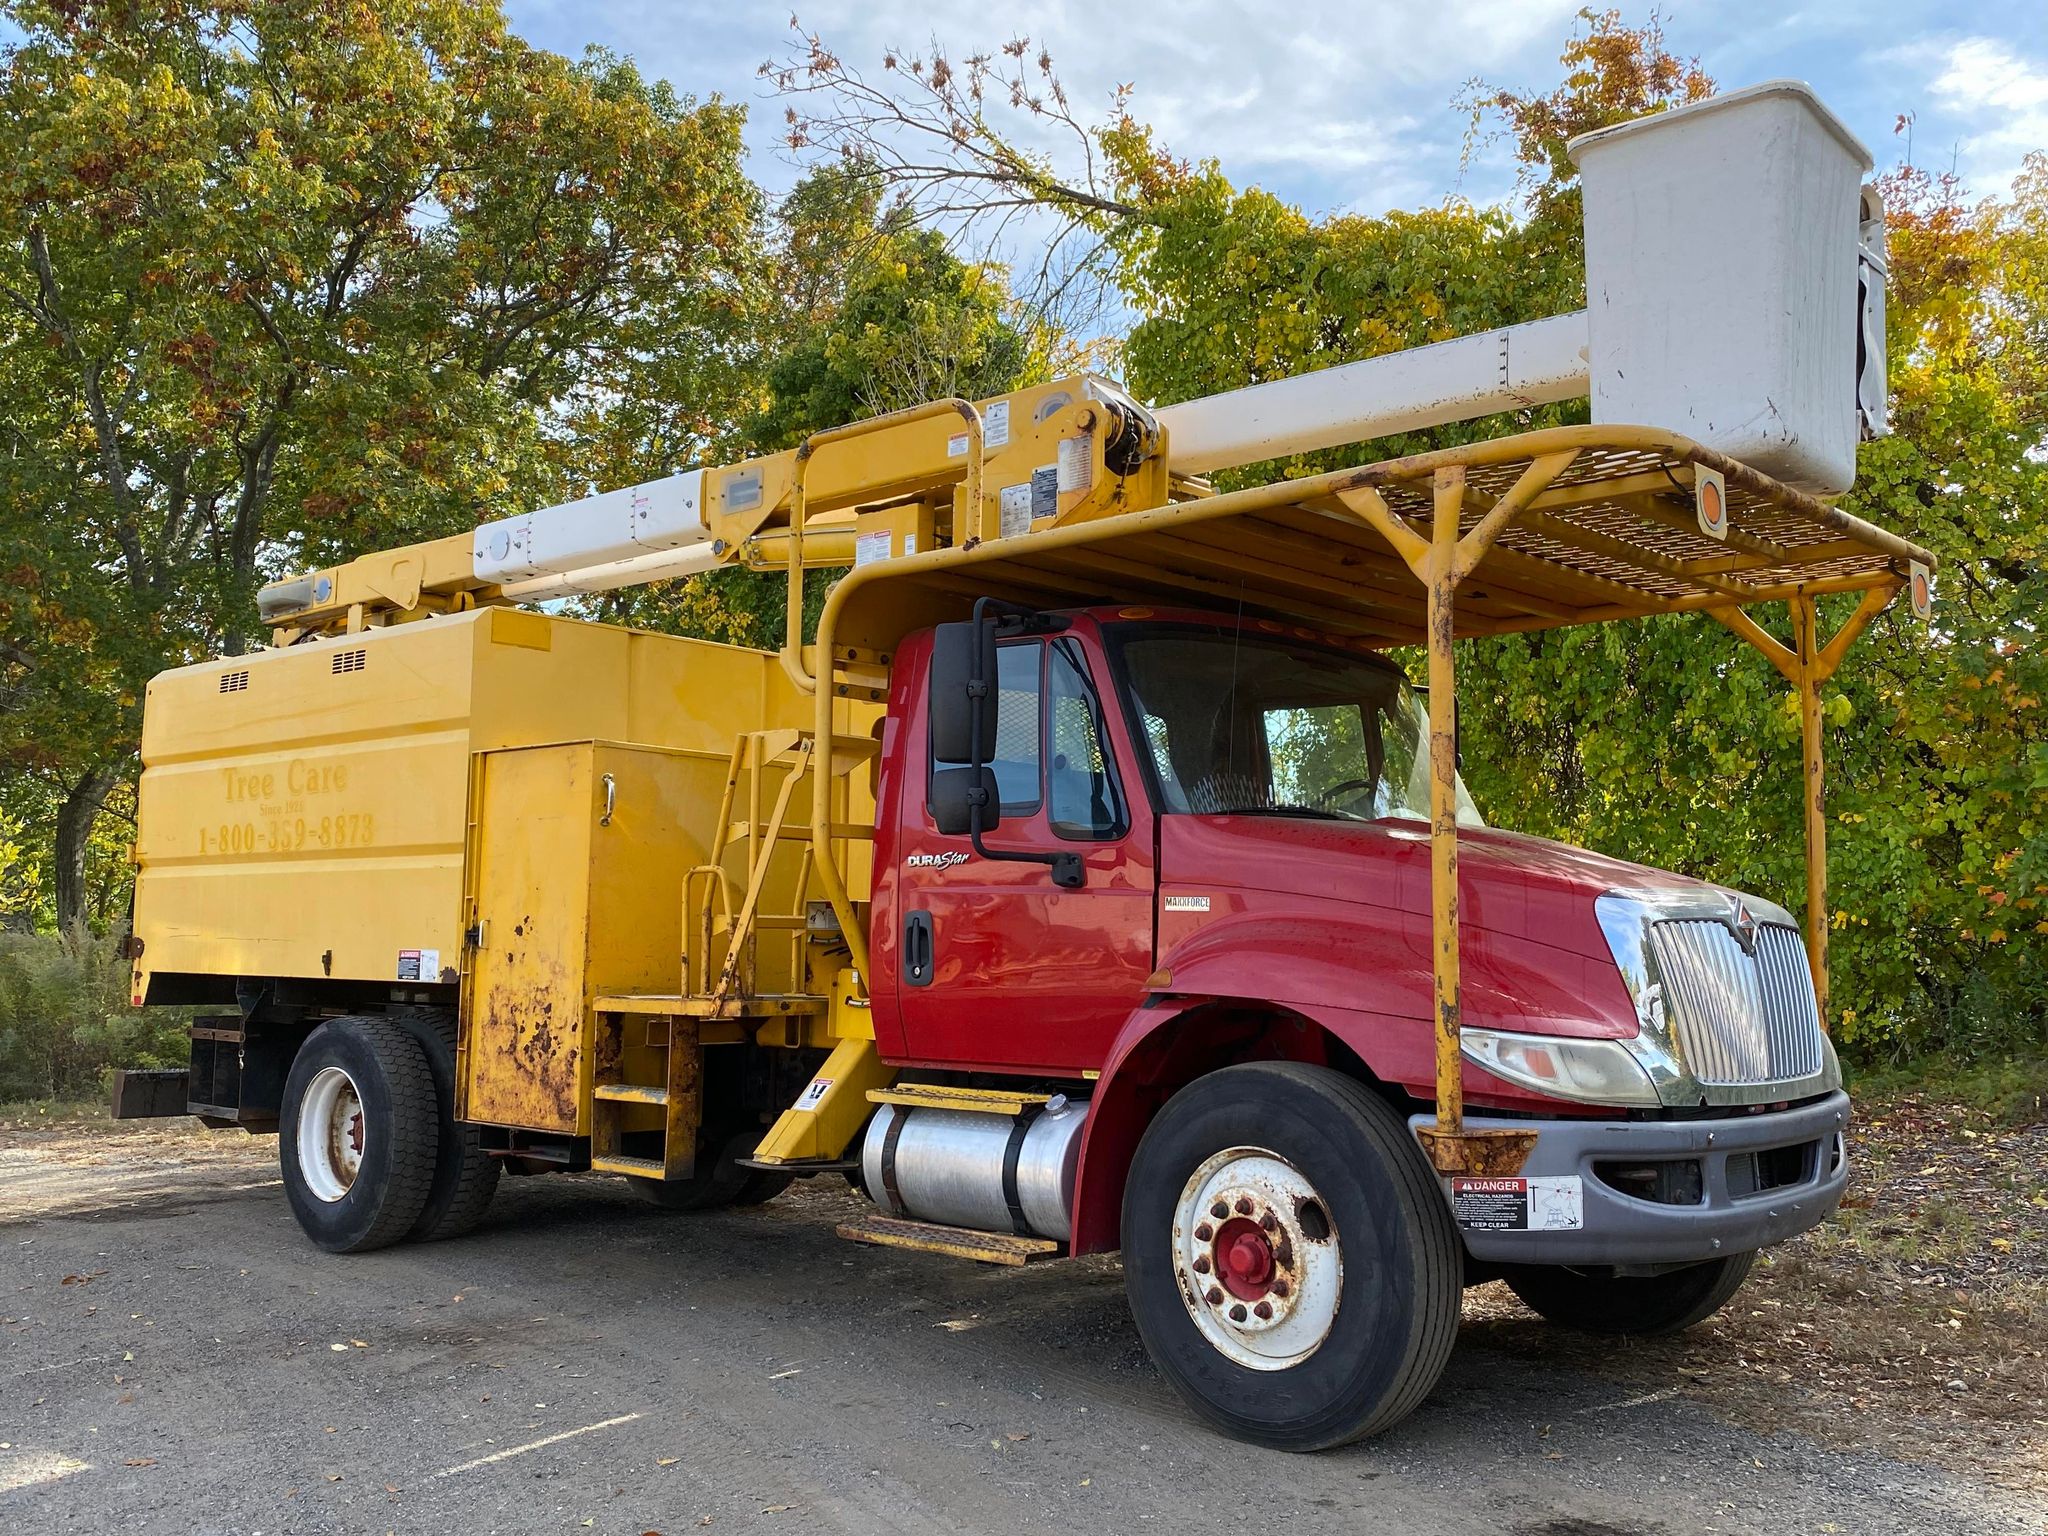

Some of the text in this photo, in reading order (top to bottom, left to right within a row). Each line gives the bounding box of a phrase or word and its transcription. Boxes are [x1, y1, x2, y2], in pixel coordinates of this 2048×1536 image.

[223, 758, 348, 802] Tree Care
[259, 803, 282, 816] Since
[1165, 897, 1209, 908] MAXXFORCE
[1474, 1181, 1519, 1191] DANGER
